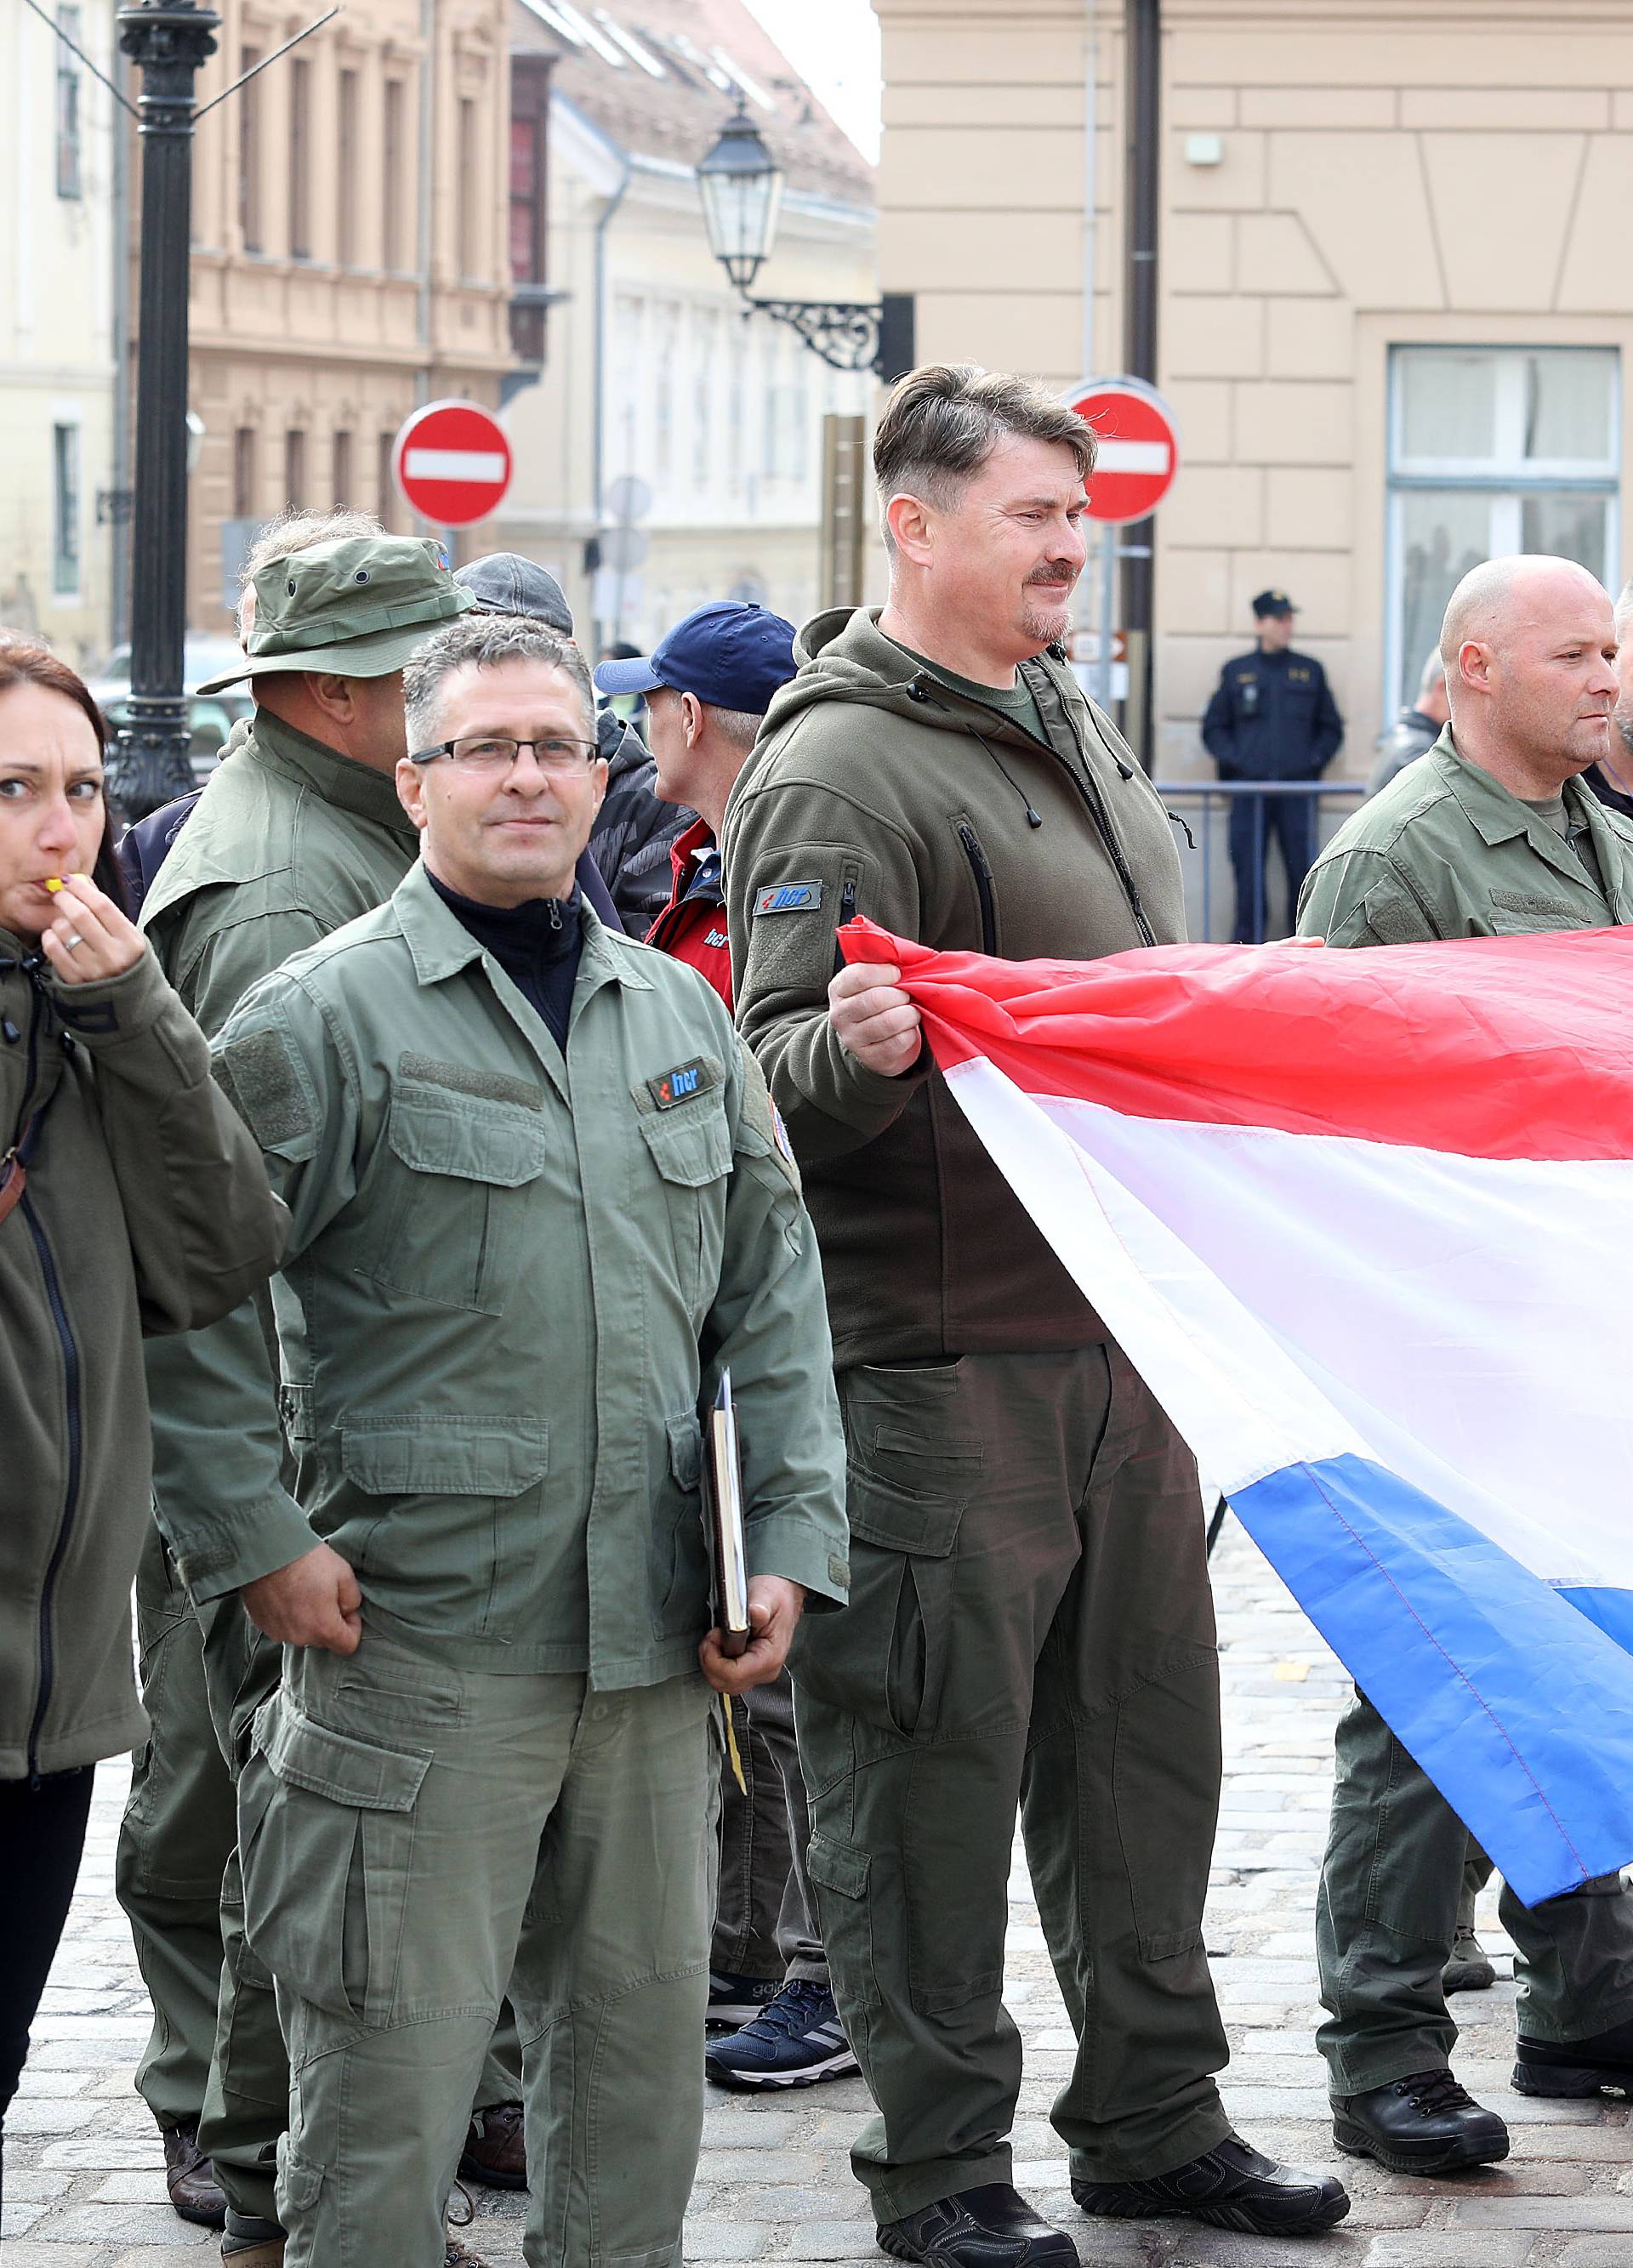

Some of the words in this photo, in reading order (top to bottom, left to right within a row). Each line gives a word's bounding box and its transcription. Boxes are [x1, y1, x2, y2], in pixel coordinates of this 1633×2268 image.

[774, 886, 808, 907] hcr
[703, 928, 729, 946] hcr
[672, 1068, 697, 1096] hcr
